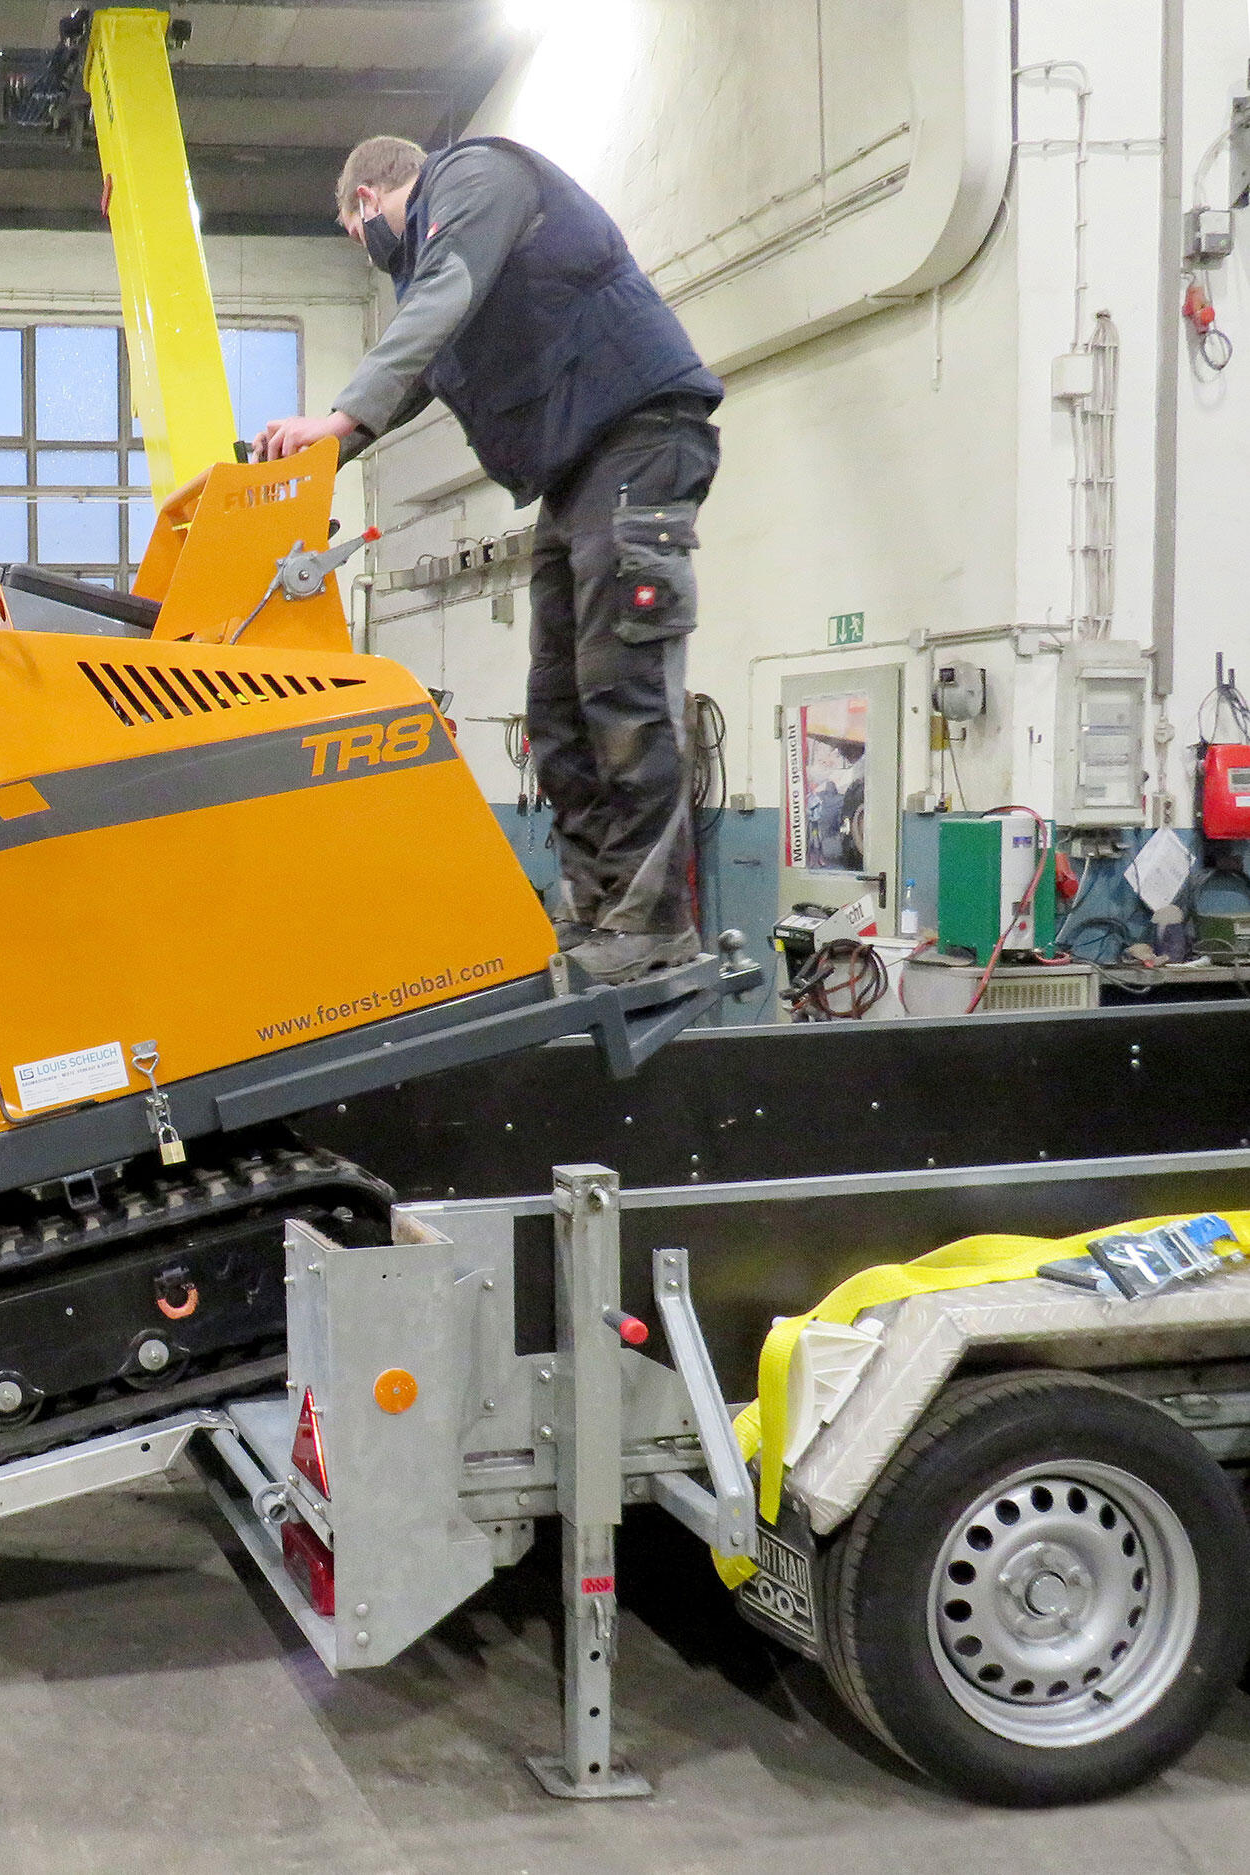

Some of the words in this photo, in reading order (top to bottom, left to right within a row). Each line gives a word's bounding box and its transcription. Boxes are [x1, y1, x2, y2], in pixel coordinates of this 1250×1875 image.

[300, 714, 434, 777] TR8
[788, 724, 801, 785] gesucht
[790, 790, 803, 862] Monteure
[256, 956, 504, 1042] www.foerst-global.com
[37, 1059, 67, 1076] LOUIS
[70, 1047, 118, 1068] SCHEUCH
